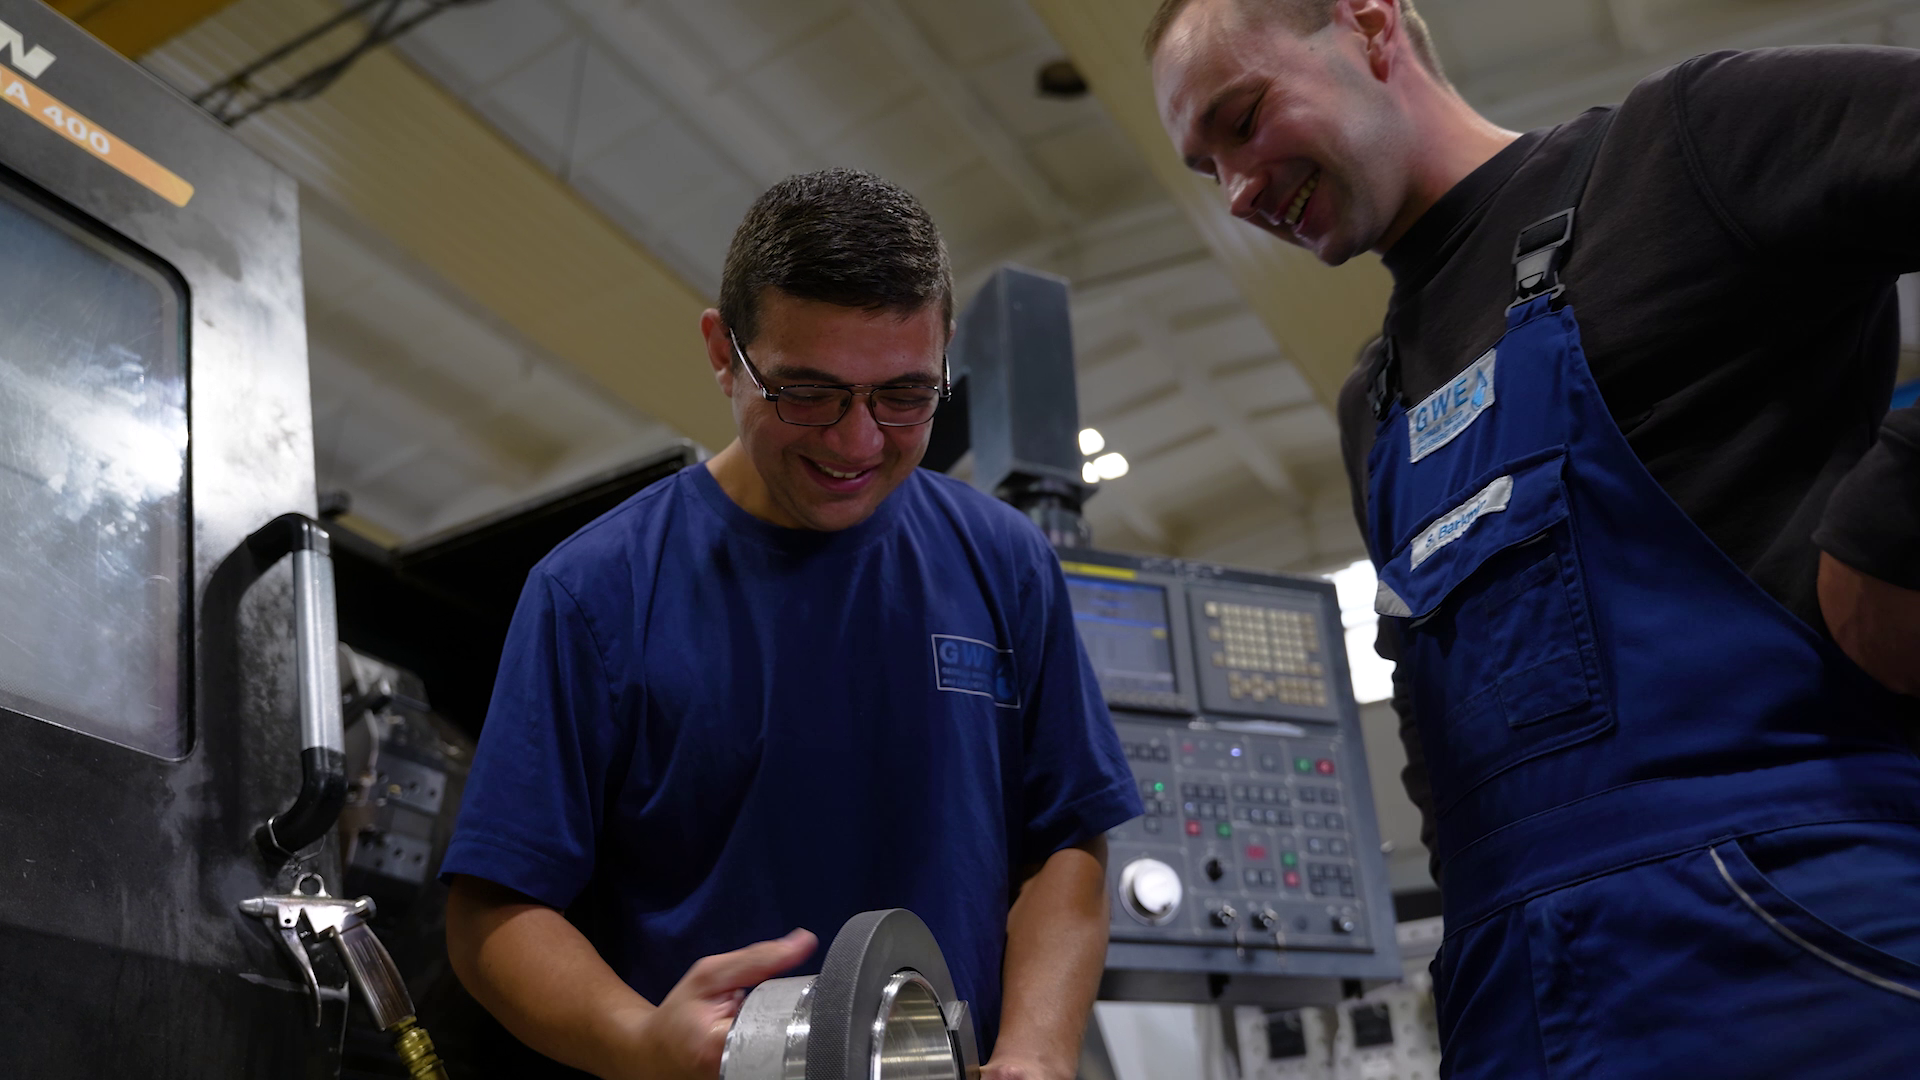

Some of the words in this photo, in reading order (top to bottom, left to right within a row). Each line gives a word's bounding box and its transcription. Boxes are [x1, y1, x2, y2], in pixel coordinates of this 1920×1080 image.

[0, 74, 30, 107] A
[43, 105, 110, 155] 400
[1415, 377, 1469, 433] GWE
